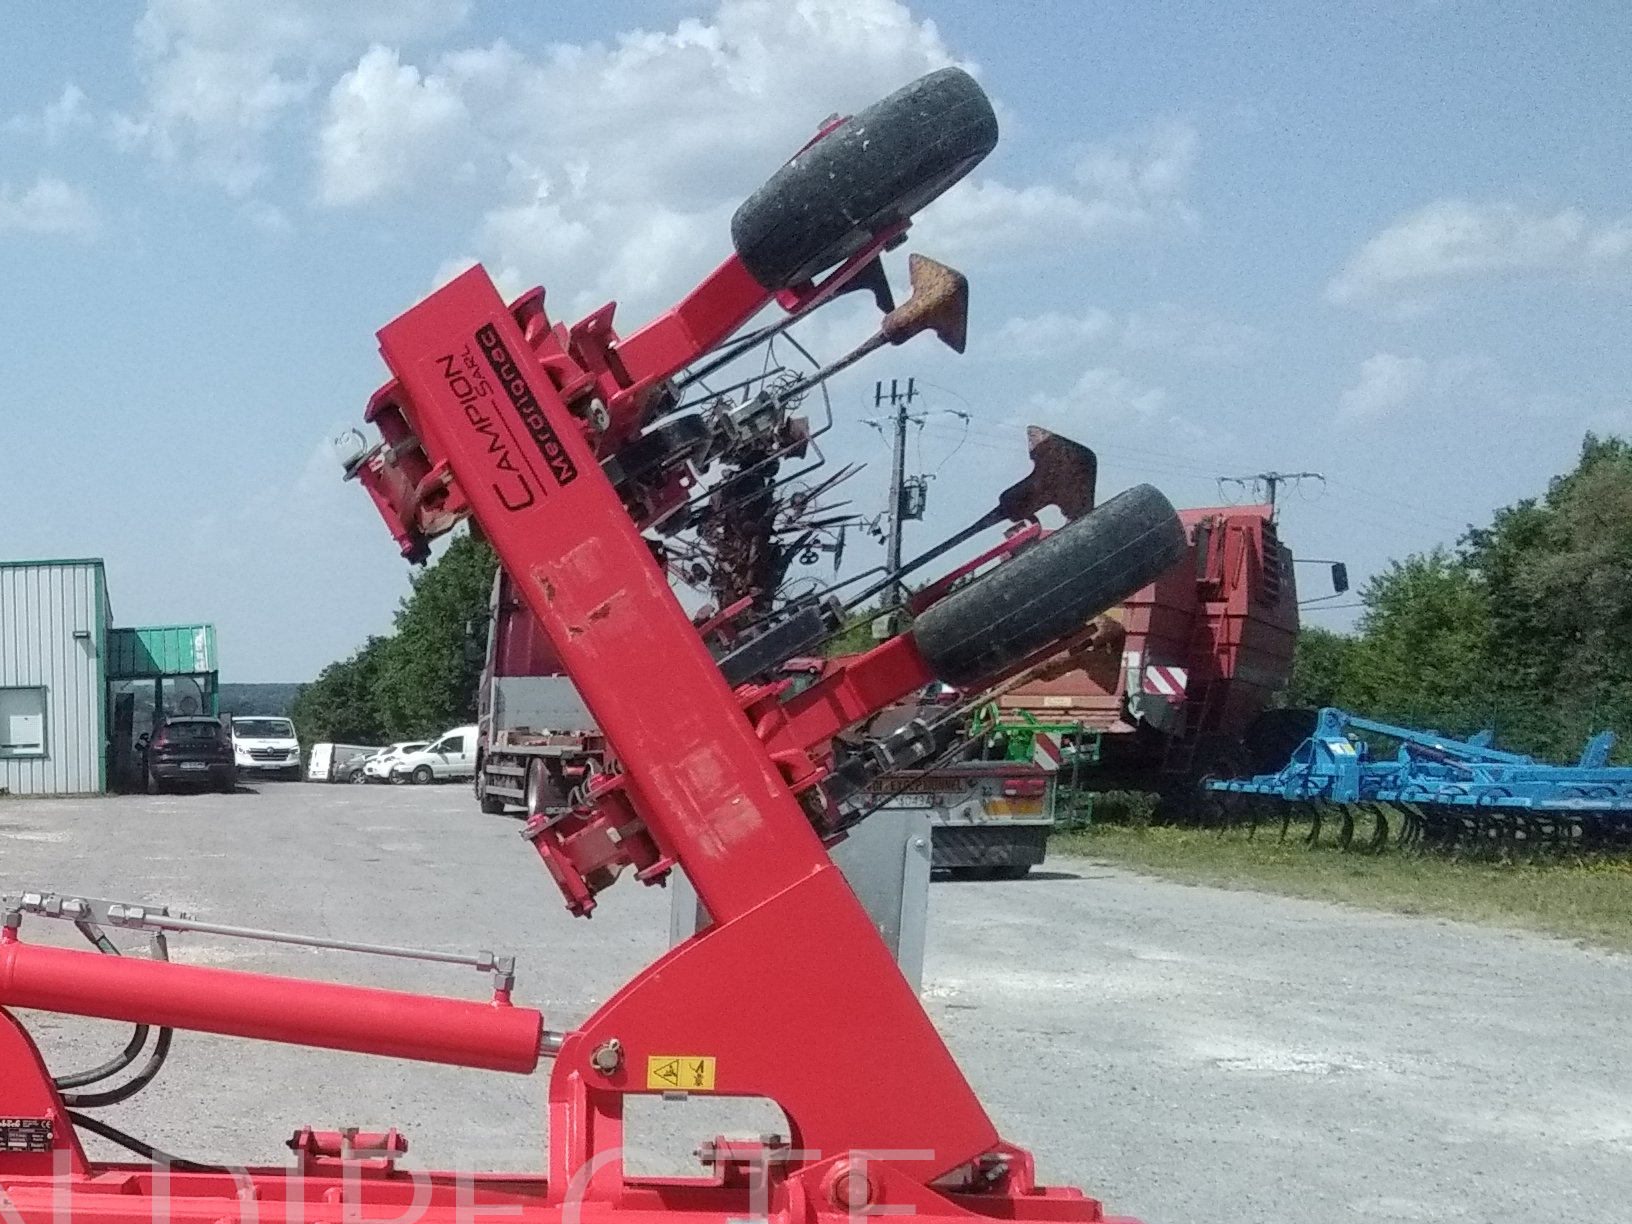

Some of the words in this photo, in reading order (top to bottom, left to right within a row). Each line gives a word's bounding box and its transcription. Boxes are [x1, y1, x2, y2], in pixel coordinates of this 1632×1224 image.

[435, 354, 535, 511] CAMPION
[462, 345, 494, 397] SARL
[479, 329, 573, 483] Merdrignac
